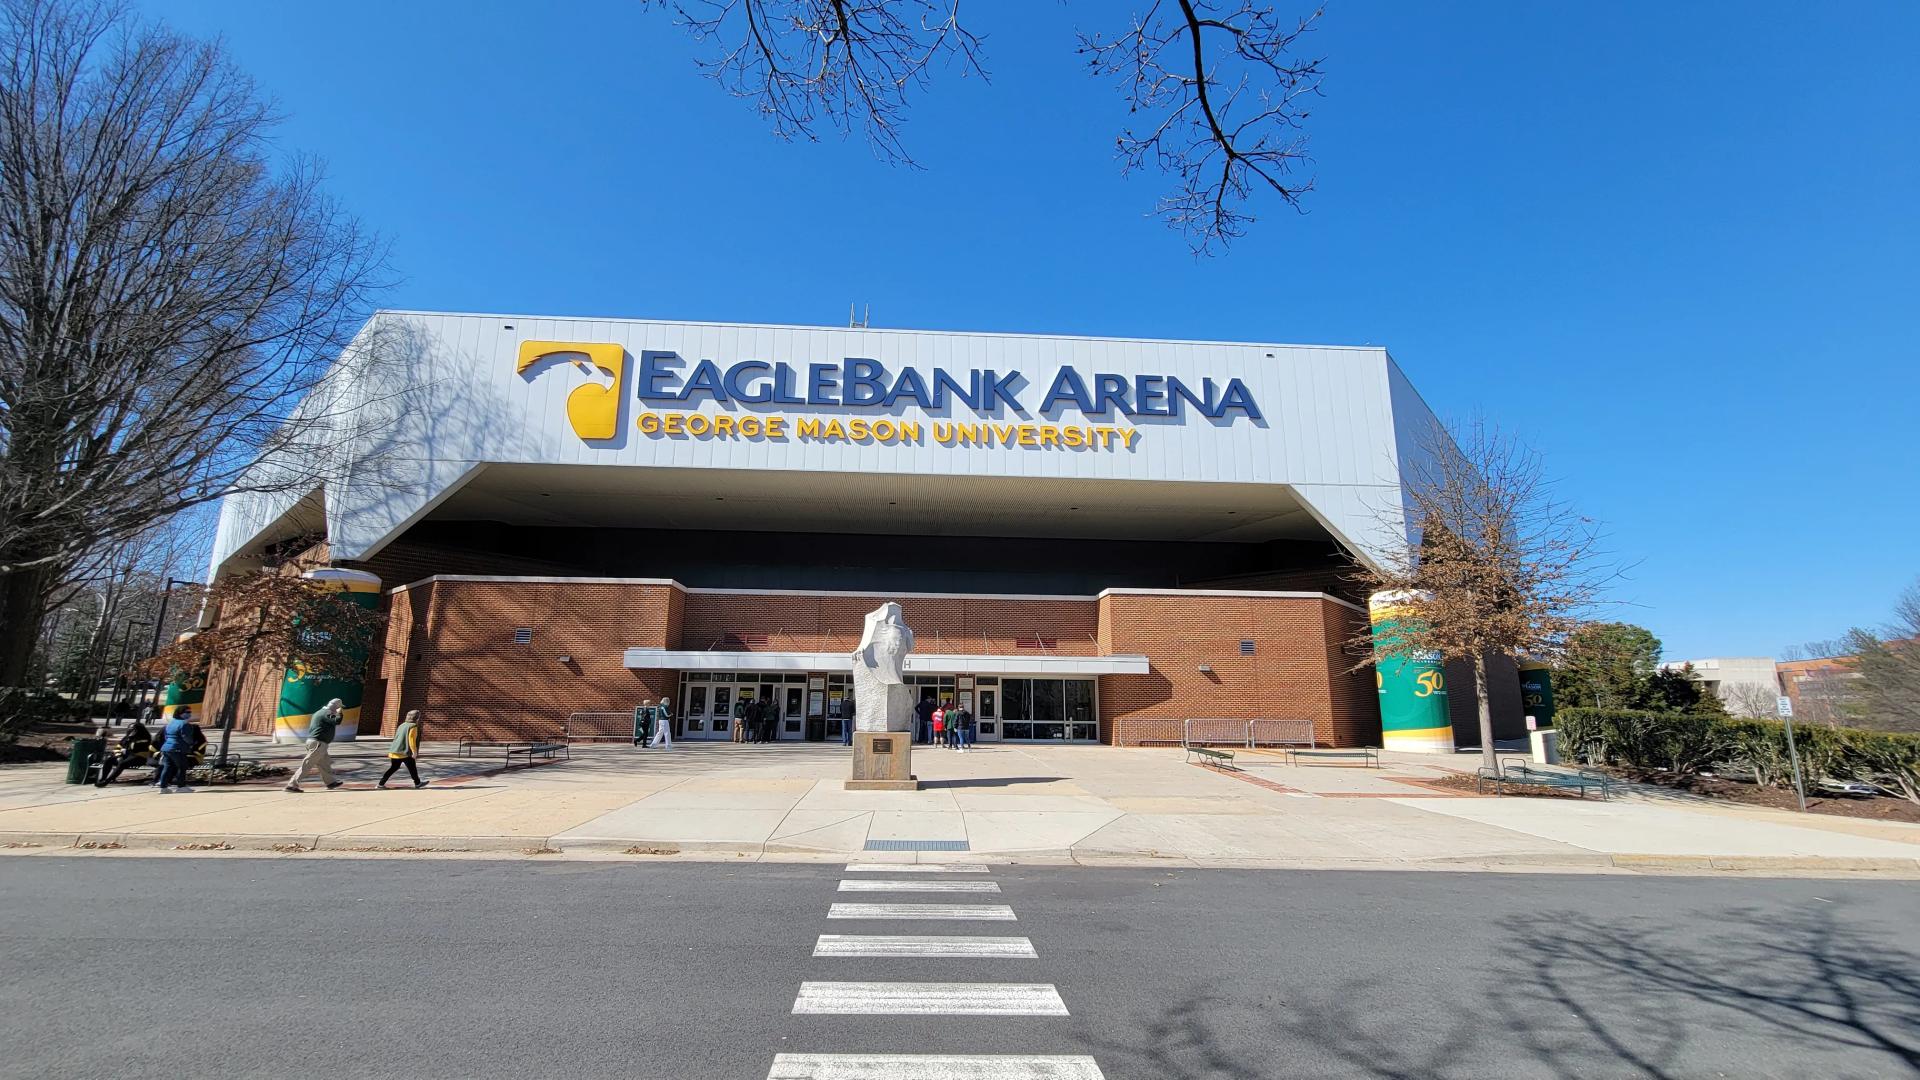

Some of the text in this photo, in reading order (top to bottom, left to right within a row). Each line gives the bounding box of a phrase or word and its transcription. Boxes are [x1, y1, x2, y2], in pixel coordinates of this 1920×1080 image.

[638, 351, 1262, 419] EAGLEBANK ARENA
[637, 413, 1134, 447] GEORGE MASON UNIVERSITY
[1414, 669, 1443, 697] 50
